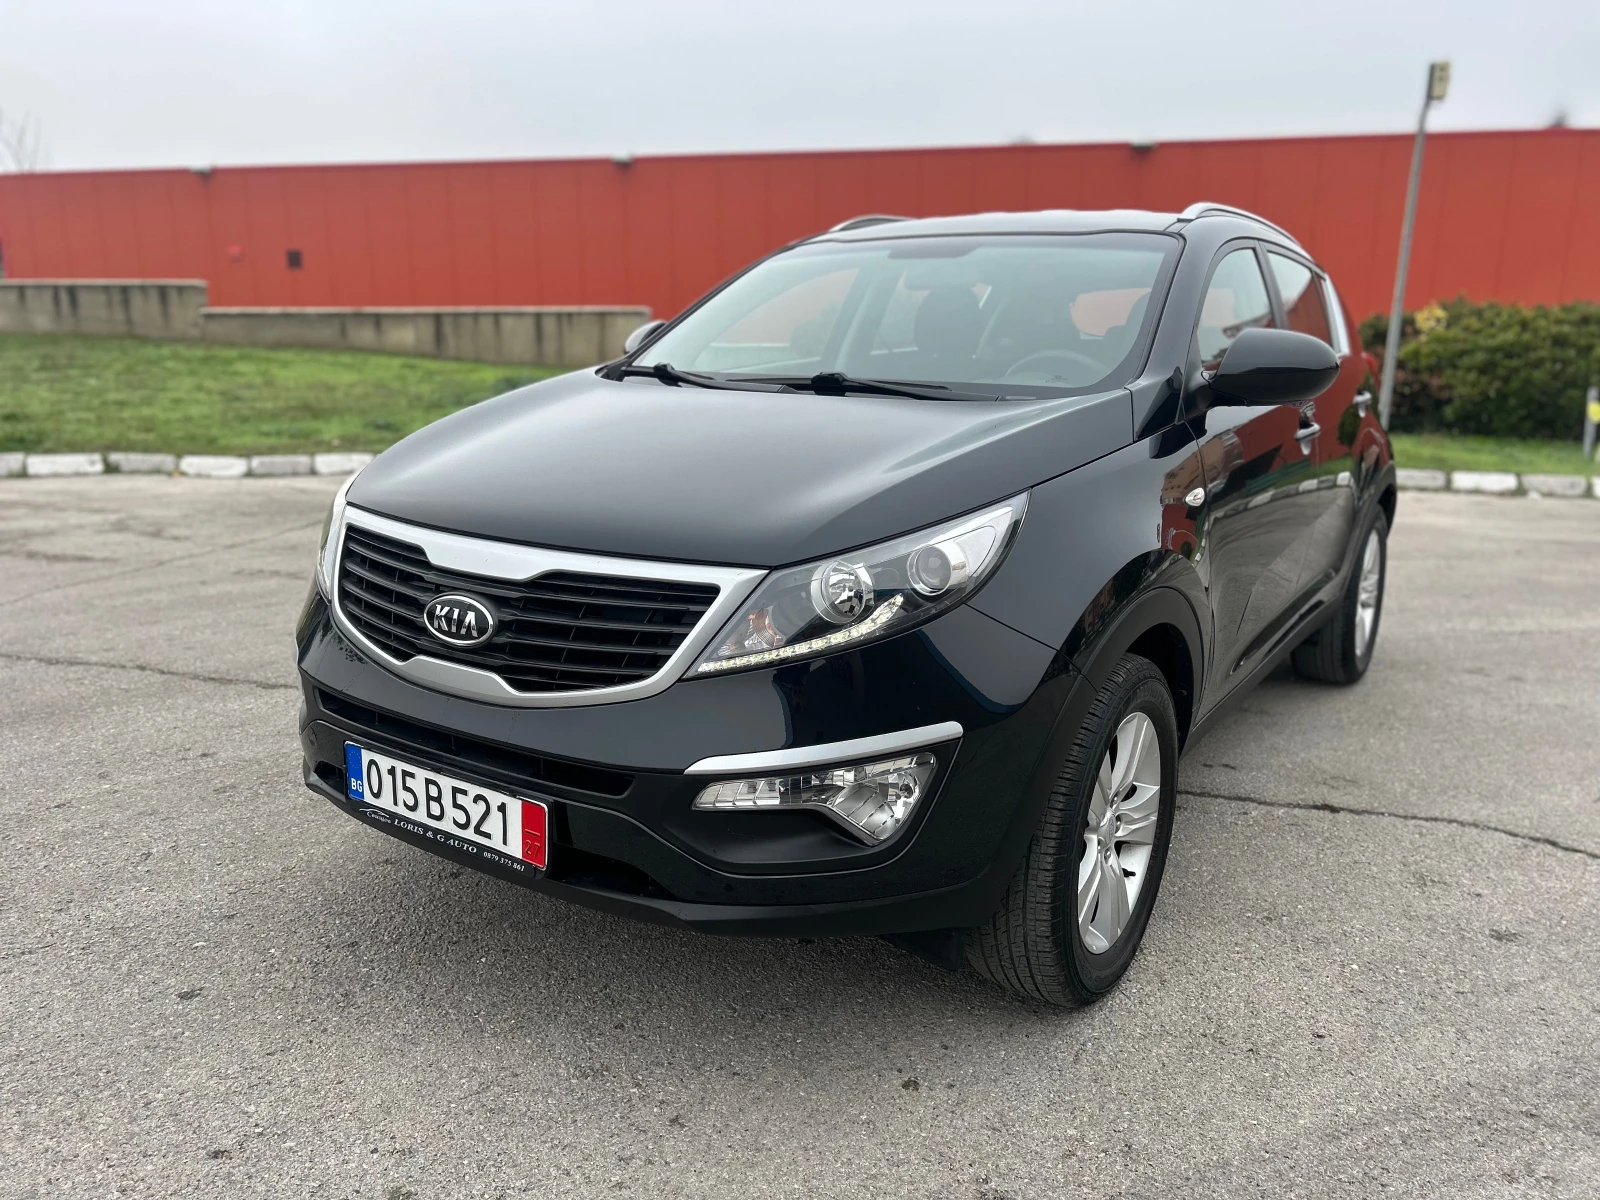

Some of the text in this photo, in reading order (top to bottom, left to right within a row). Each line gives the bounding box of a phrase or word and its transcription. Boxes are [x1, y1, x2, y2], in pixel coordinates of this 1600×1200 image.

[433, 604, 479, 638] KIA
[350, 777, 363, 794] BG
[366, 758, 508, 847] 015B521
[394, 818, 525, 873] LORIS & G AUTO 0879 375 861
[525, 839, 541, 858] 27
